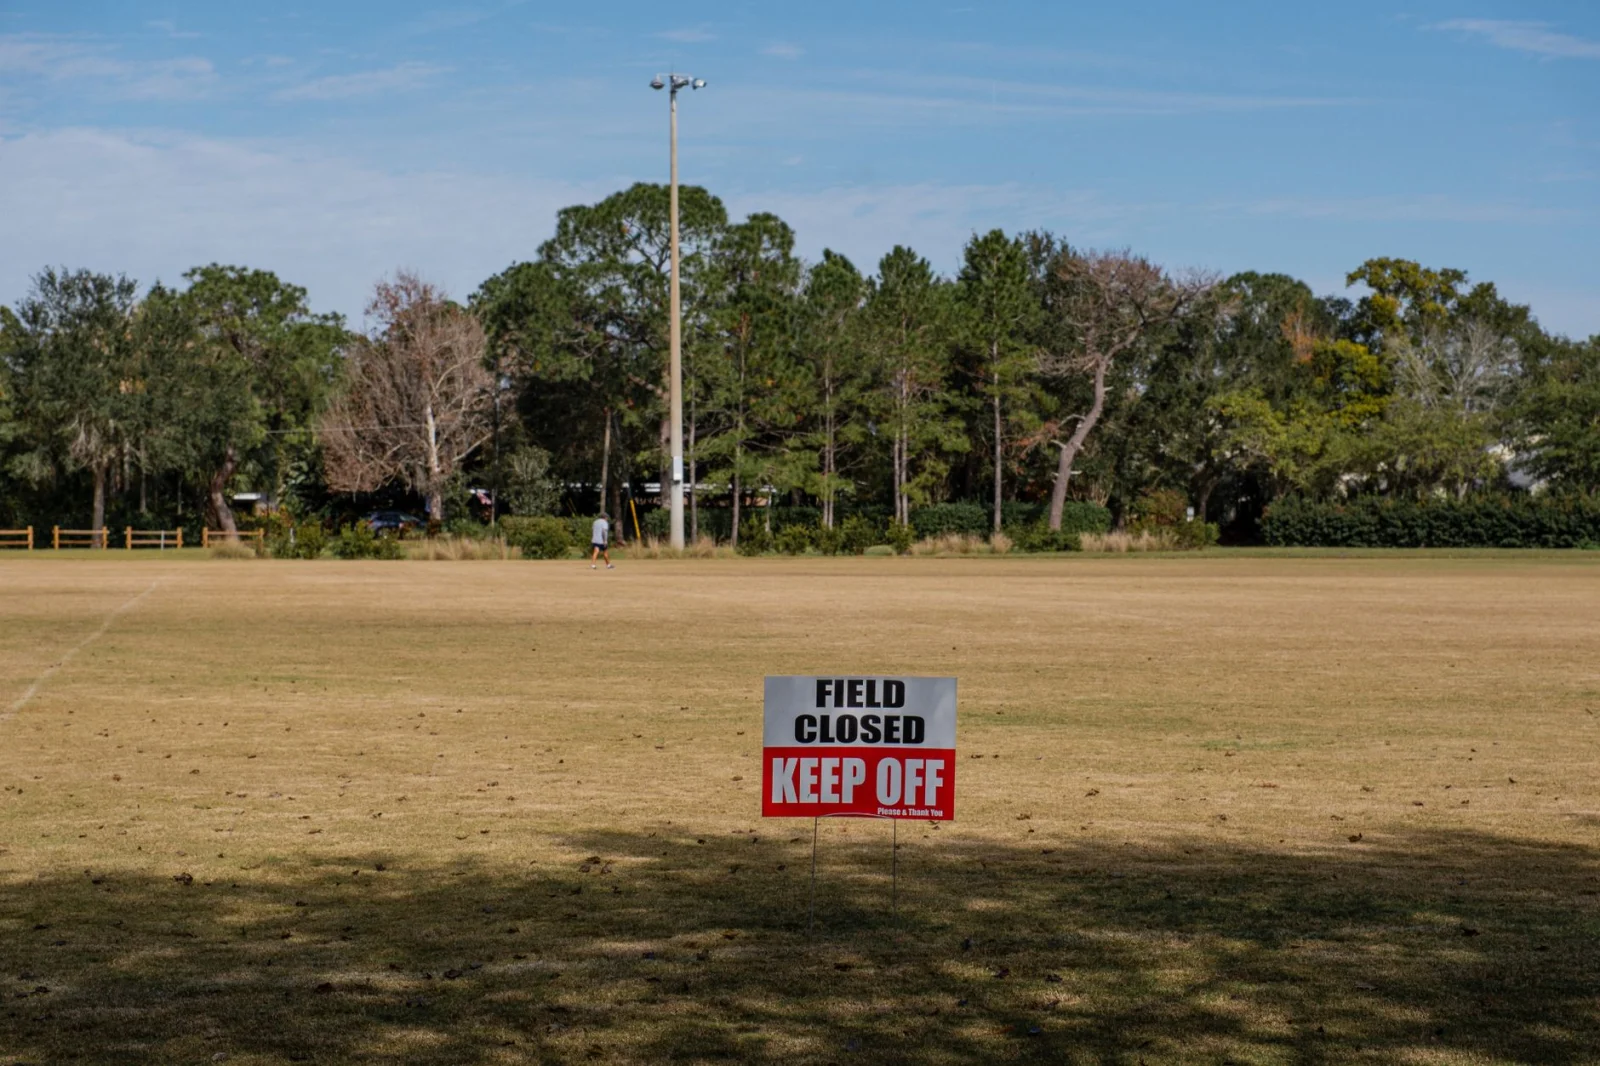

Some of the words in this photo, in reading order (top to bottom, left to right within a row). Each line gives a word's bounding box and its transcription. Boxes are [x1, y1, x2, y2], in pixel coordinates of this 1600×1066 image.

[816, 679, 905, 708] FIELD
[795, 714, 925, 744] CLOSED
[771, 757, 866, 804] KEEP
[876, 757, 945, 806] OFF
[877, 808, 901, 816] Please
[908, 808, 929, 816] Thank
[930, 809, 943, 817] You
